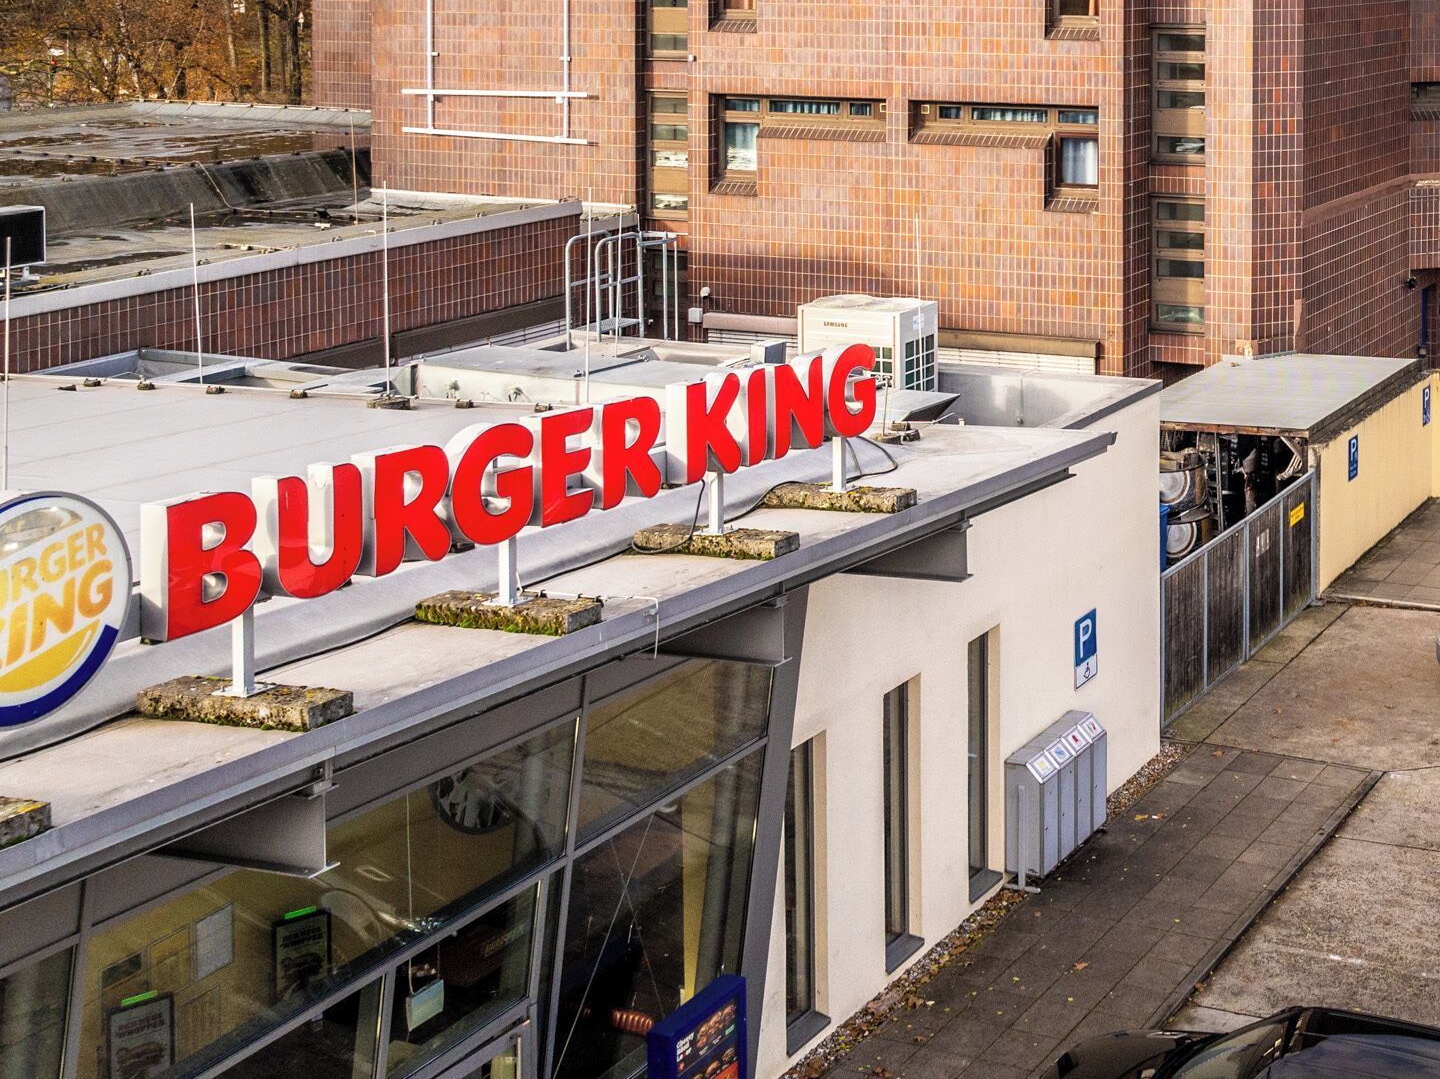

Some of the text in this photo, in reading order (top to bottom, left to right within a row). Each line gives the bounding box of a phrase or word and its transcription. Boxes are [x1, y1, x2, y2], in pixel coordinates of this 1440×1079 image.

[1424, 388, 1429, 409] P
[1350, 438, 1357, 462] P
[163, 343, 877, 643] BURGER KING
[0, 521, 108, 609] RGER
[0, 559, 113, 669] ING
[1079, 618, 1093, 659] P
